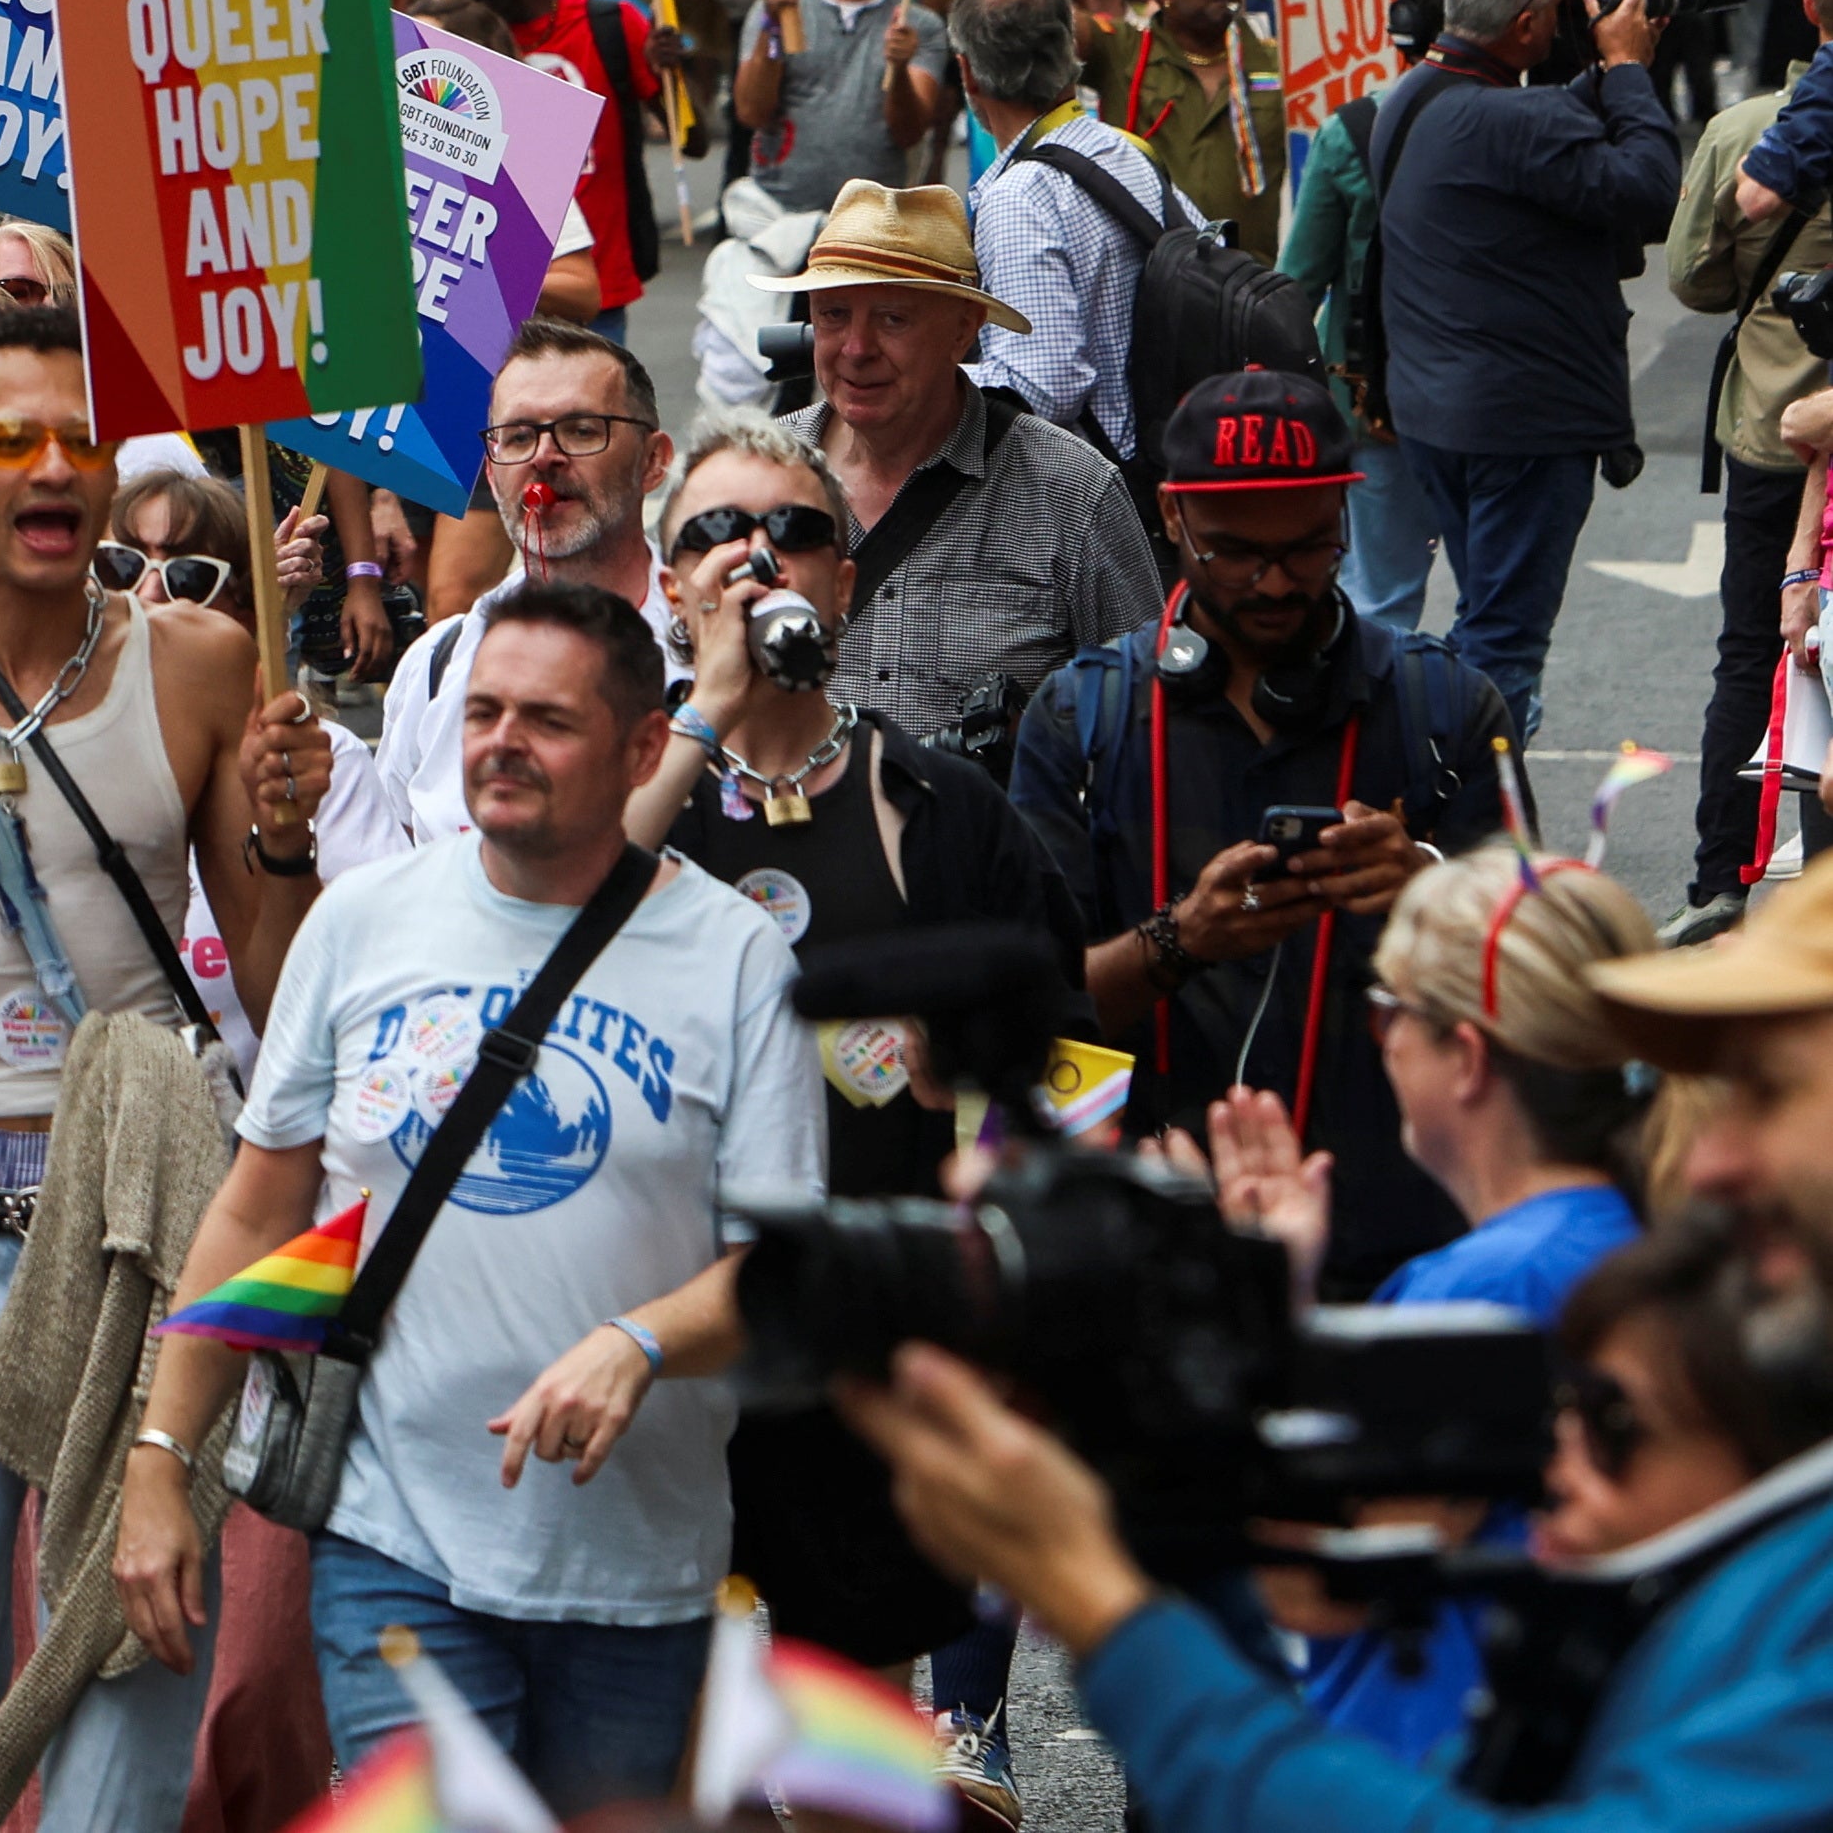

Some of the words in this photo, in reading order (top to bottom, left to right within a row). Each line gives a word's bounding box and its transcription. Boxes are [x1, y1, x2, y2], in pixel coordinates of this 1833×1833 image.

[155, 72, 320, 177] HOPE
[400, 103, 491, 150] GBT.FOUNDATION
[431, 60, 490, 120] FOUNDATION
[420, 133, 428, 146] 3
[430, 137, 444, 152] 30
[446, 144, 461, 159] 30
[462, 150, 477, 166] 30
[186, 177, 313, 277] AND
[405, 167, 498, 264] EER
[183, 278, 329, 379] JOY!
[1214, 415, 1317, 466] READ
[369, 987, 674, 1124] DOITES
